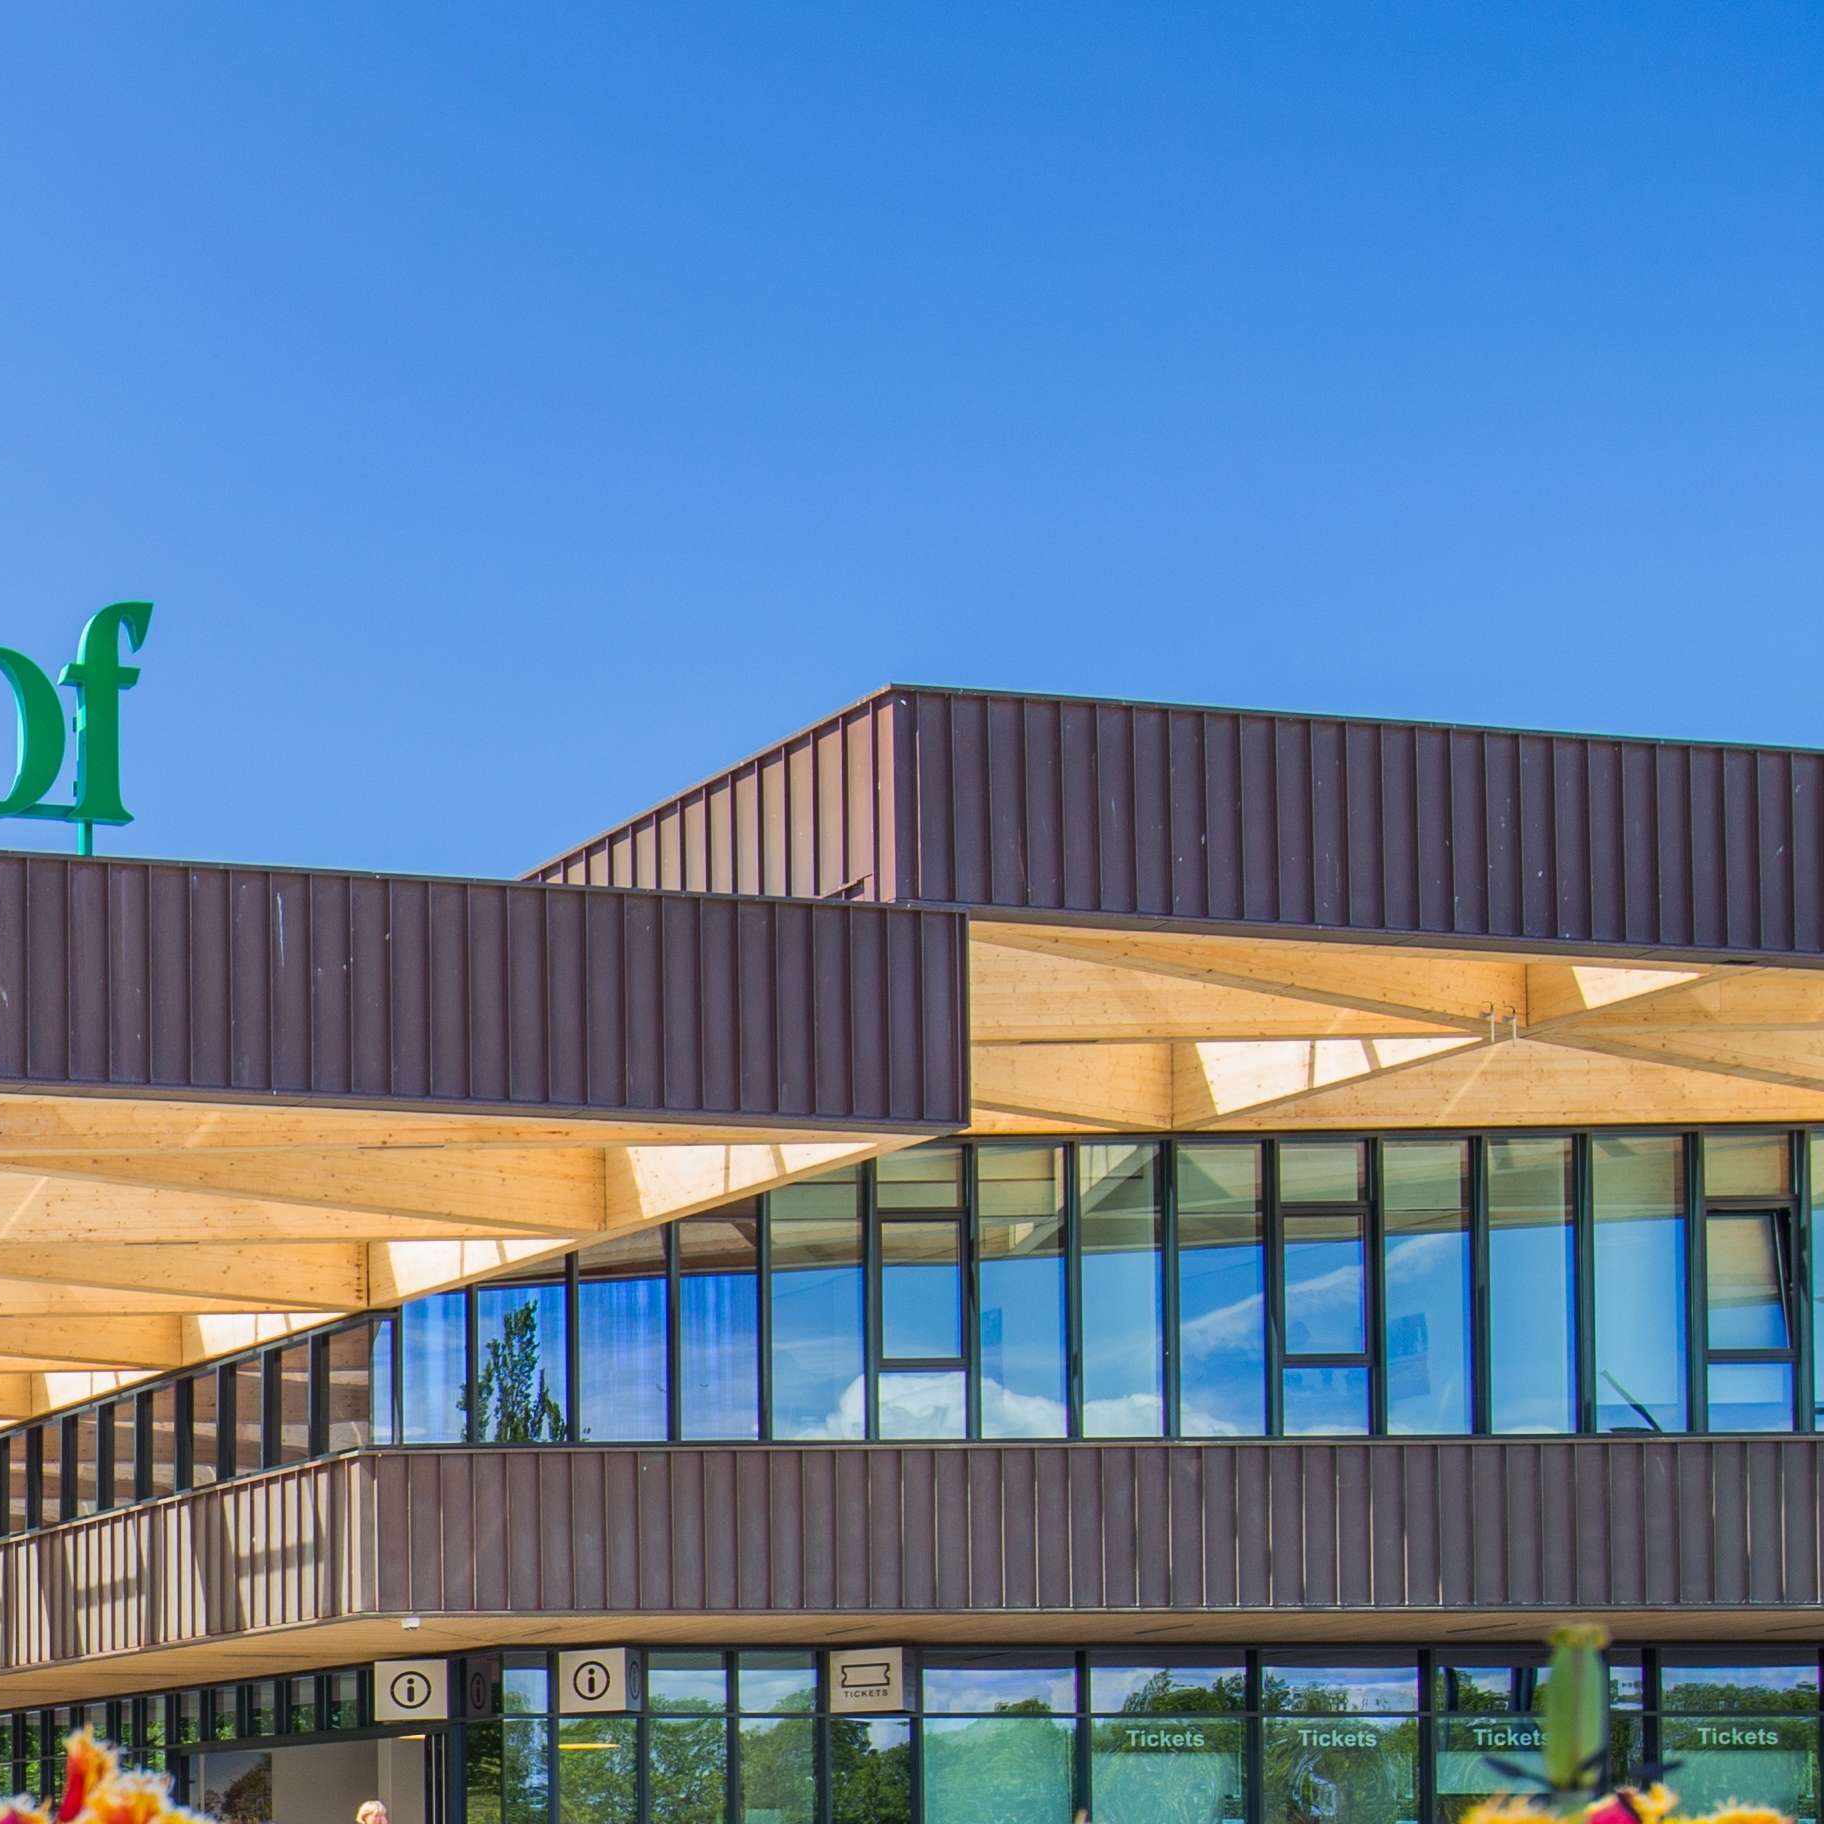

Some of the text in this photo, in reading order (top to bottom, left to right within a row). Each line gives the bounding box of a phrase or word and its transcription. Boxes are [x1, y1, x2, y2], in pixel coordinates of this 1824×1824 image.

[844, 1688, 889, 1699] TICKETS
[1125, 1729, 1205, 1748] Tickets
[1298, 1729, 1377, 1748] Tickets
[1697, 1727, 1779, 1746] Tickets
